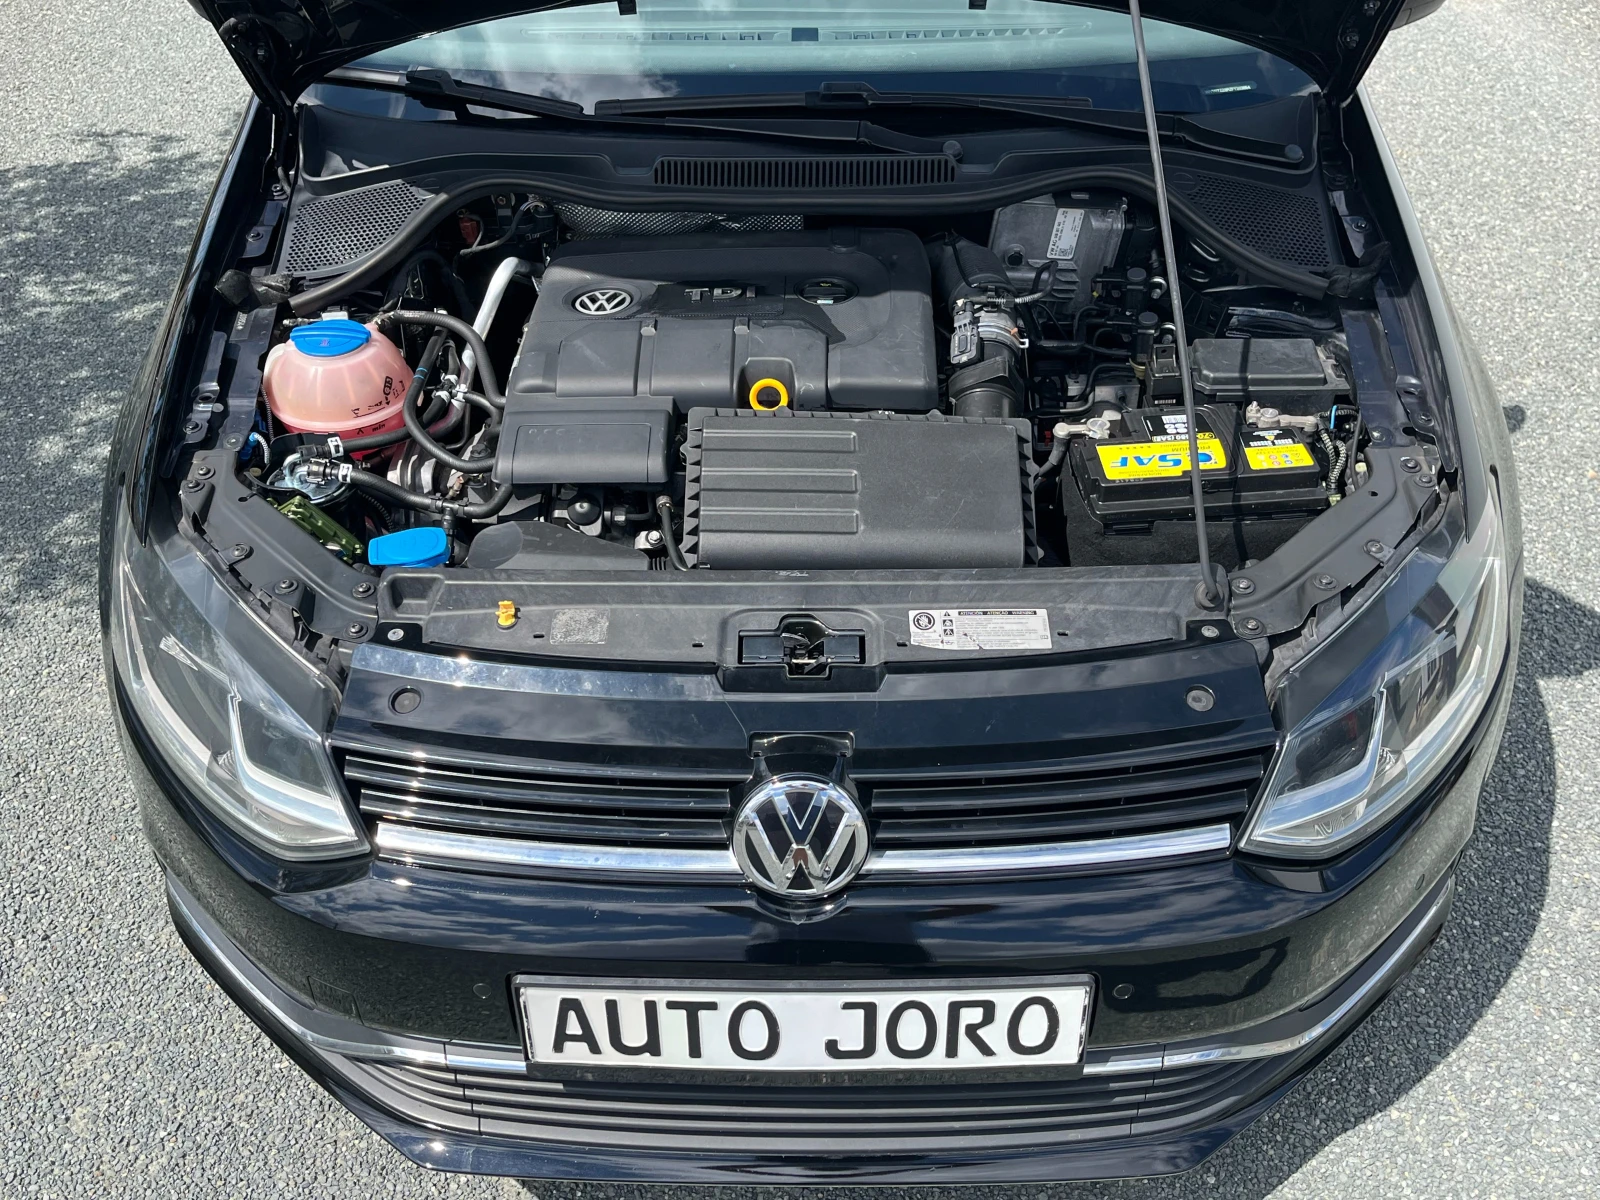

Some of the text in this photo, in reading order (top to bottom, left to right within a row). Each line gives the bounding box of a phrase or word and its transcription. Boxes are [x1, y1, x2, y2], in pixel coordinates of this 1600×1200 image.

[684, 287, 755, 302] TDI
[372, 424, 385, 432] min
[551, 995, 1061, 1060] AUTO JORO
